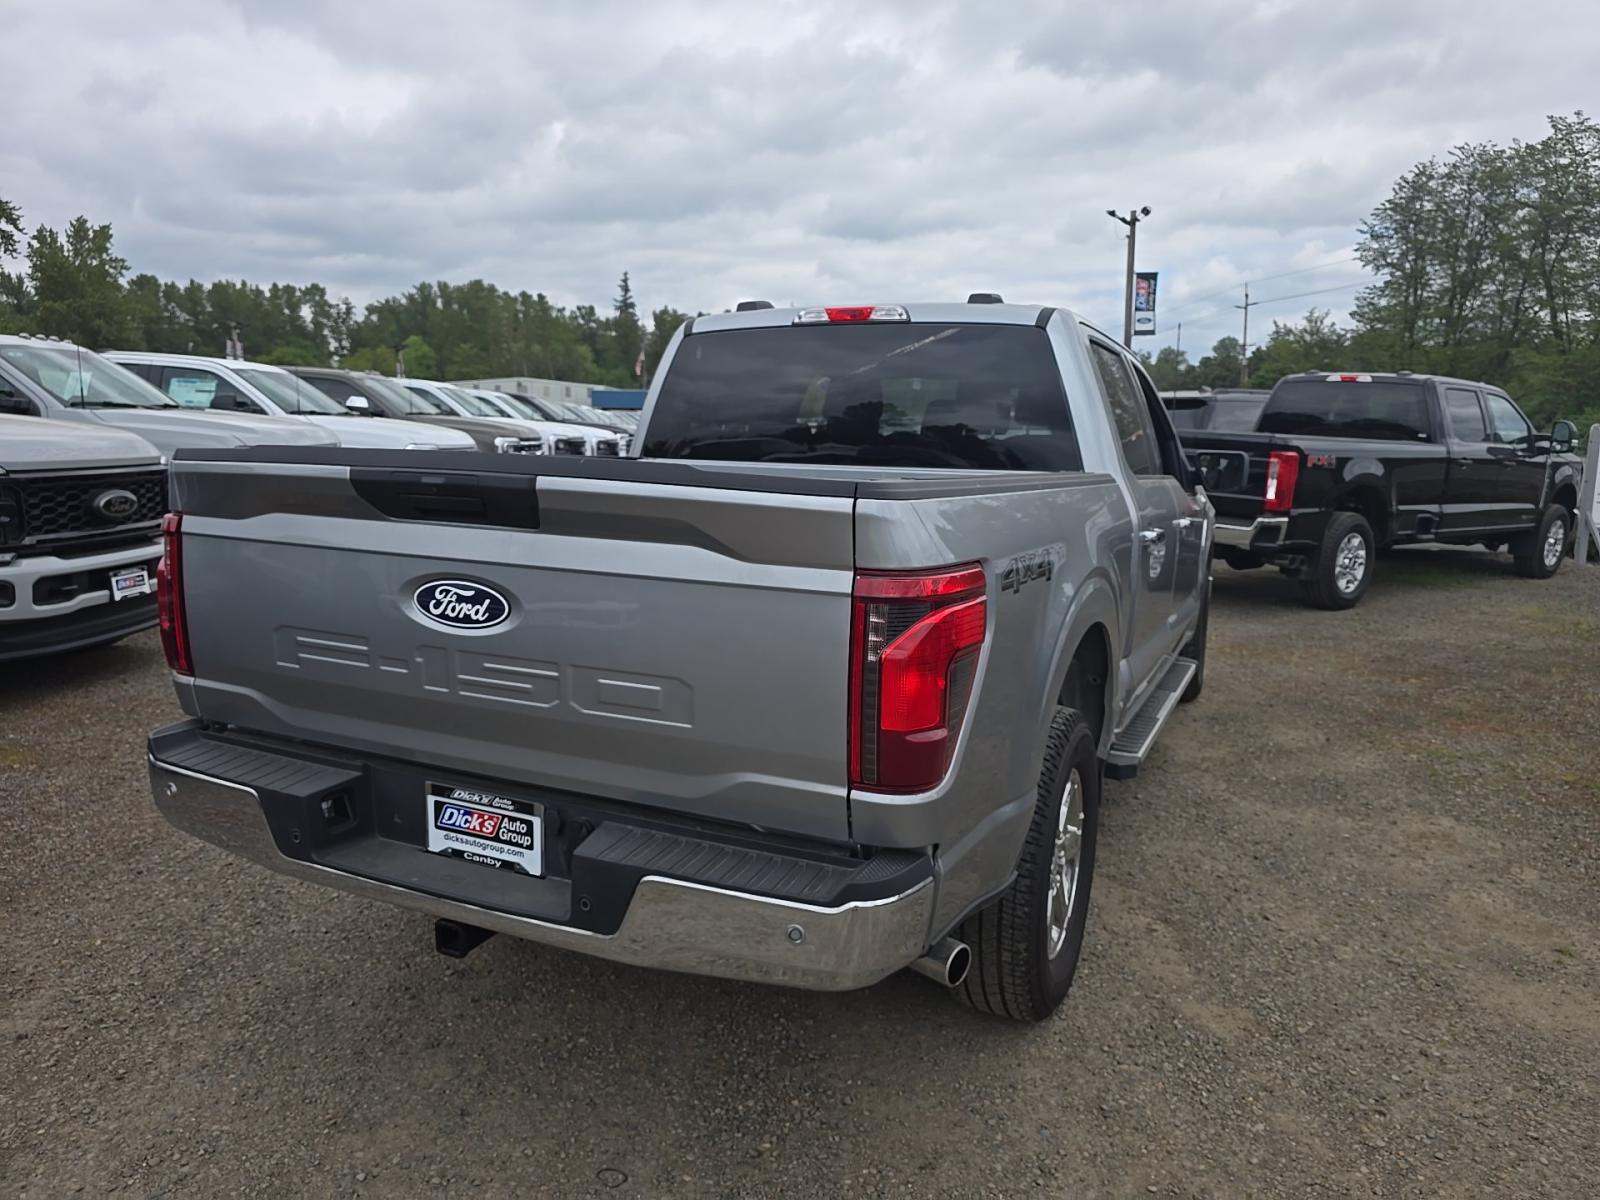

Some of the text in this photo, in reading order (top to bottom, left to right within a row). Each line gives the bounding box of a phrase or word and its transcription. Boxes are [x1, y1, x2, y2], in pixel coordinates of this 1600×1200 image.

[429, 585, 490, 622] Ford
[273, 625, 695, 728] F-150
[500, 817, 527, 833] Auto
[444, 833, 525, 858] dicksautogroup.com
[499, 828, 531, 847] Group
[463, 852, 502, 868] Canby
